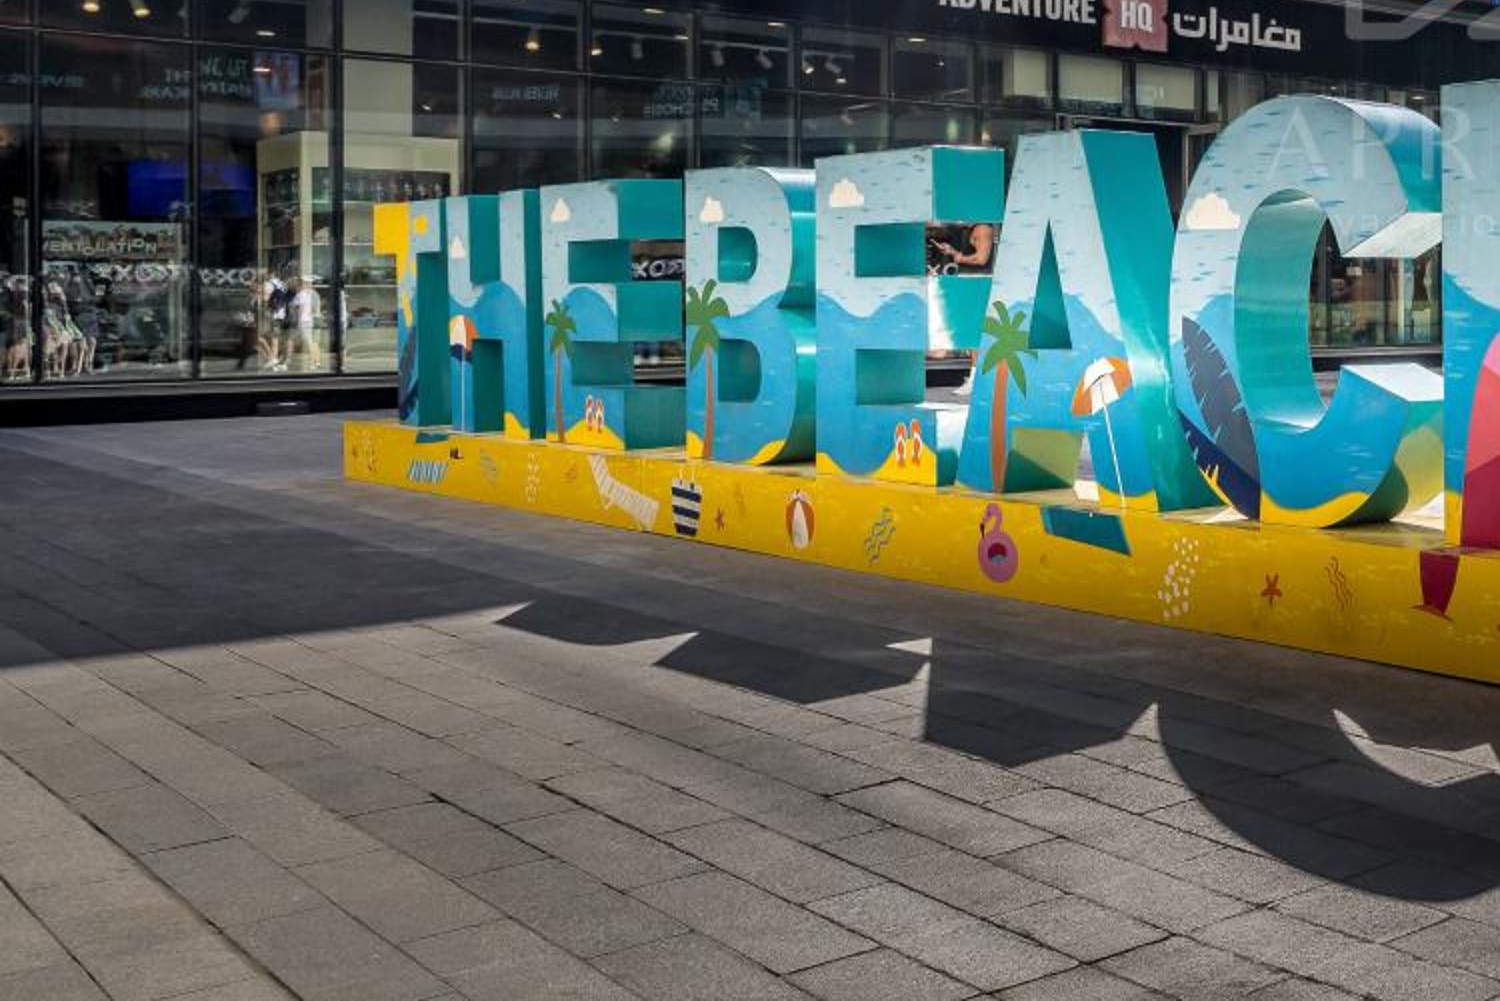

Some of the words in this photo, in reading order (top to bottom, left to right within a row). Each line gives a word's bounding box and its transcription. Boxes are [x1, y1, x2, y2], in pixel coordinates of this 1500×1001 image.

[1120, 0, 1153, 33] HQ
[1172, 6, 1301, 52] مغامرات
[371, 179, 685, 451] THE
